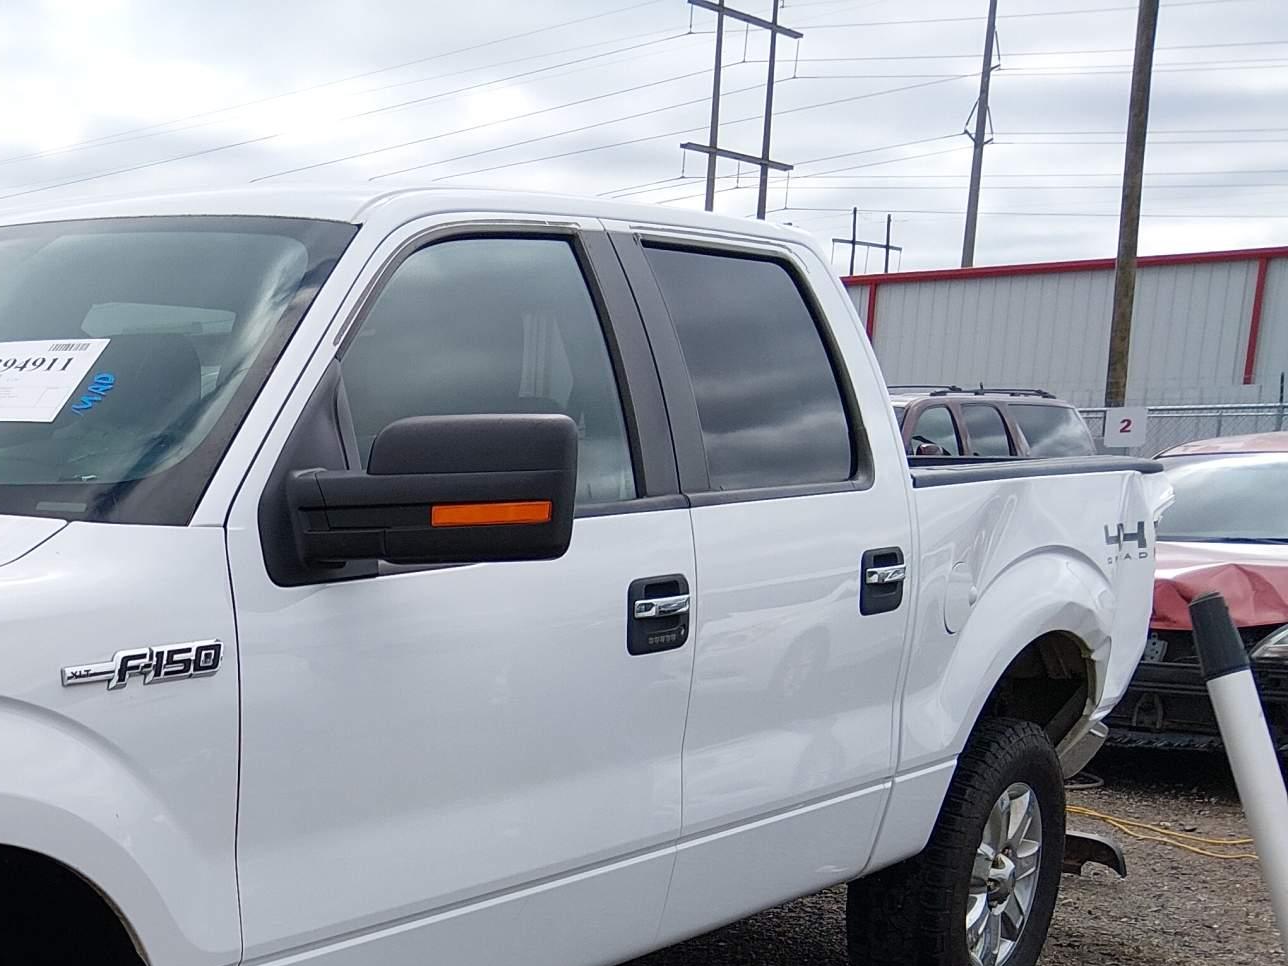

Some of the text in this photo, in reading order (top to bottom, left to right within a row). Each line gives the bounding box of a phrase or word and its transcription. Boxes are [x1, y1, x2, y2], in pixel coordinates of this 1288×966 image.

[1119, 418, 1133, 434] 2
[70, 640, 224, 688] XLT F-150
